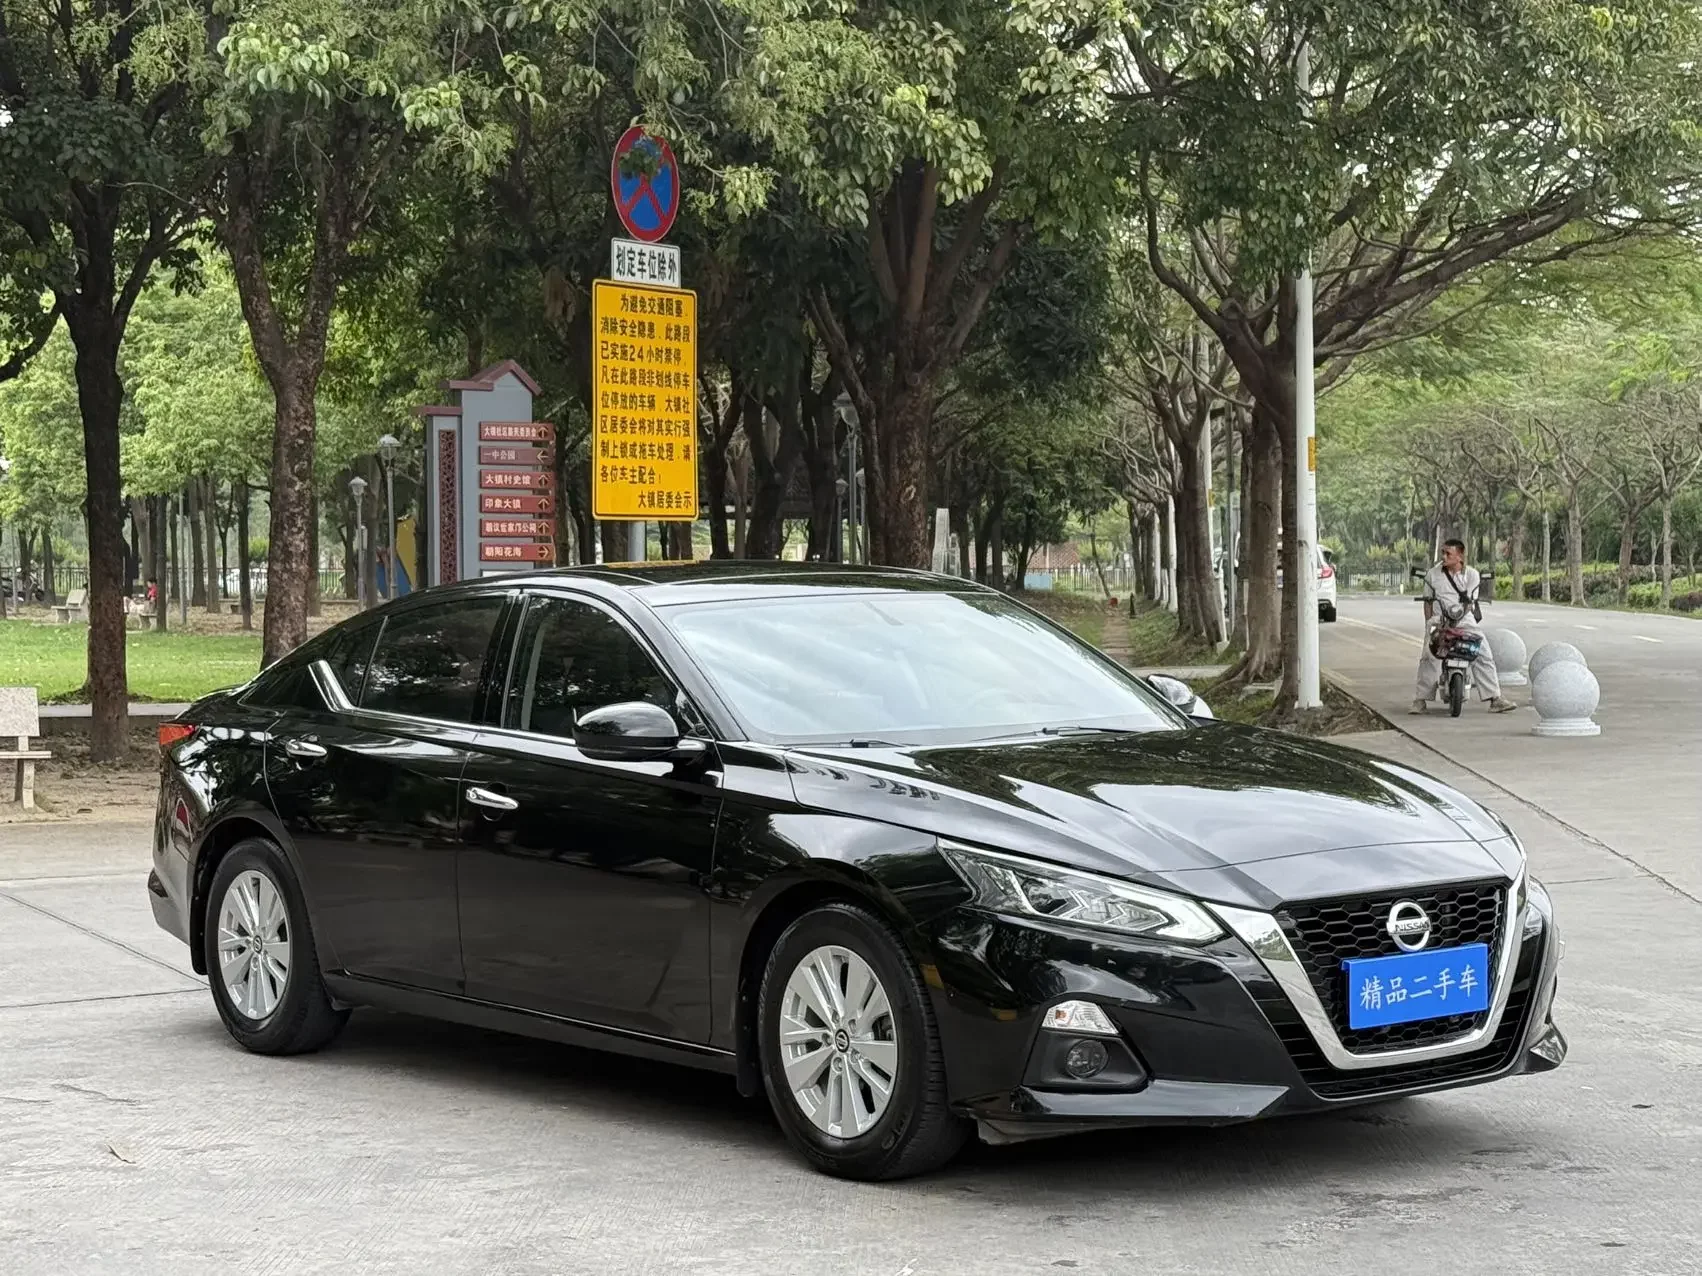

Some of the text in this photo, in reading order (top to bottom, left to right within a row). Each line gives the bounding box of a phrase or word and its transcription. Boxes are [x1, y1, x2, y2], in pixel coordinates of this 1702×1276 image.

[616, 244, 677, 283] 划定车位除外
[600, 365, 690, 391] 凡在此路段非划线停车
[600, 414, 690, 438] 区居委会将对其实行强
[485, 474, 531, 485] 大镇村史馆
[485, 498, 521, 509] 印象大镇
[638, 489, 692, 509] 大镇居委会示
[485, 546, 522, 557] 朝阳花海
[1395, 920, 1430, 932] NISSAN
[1360, 964, 1479, 1010] 精品二手车
